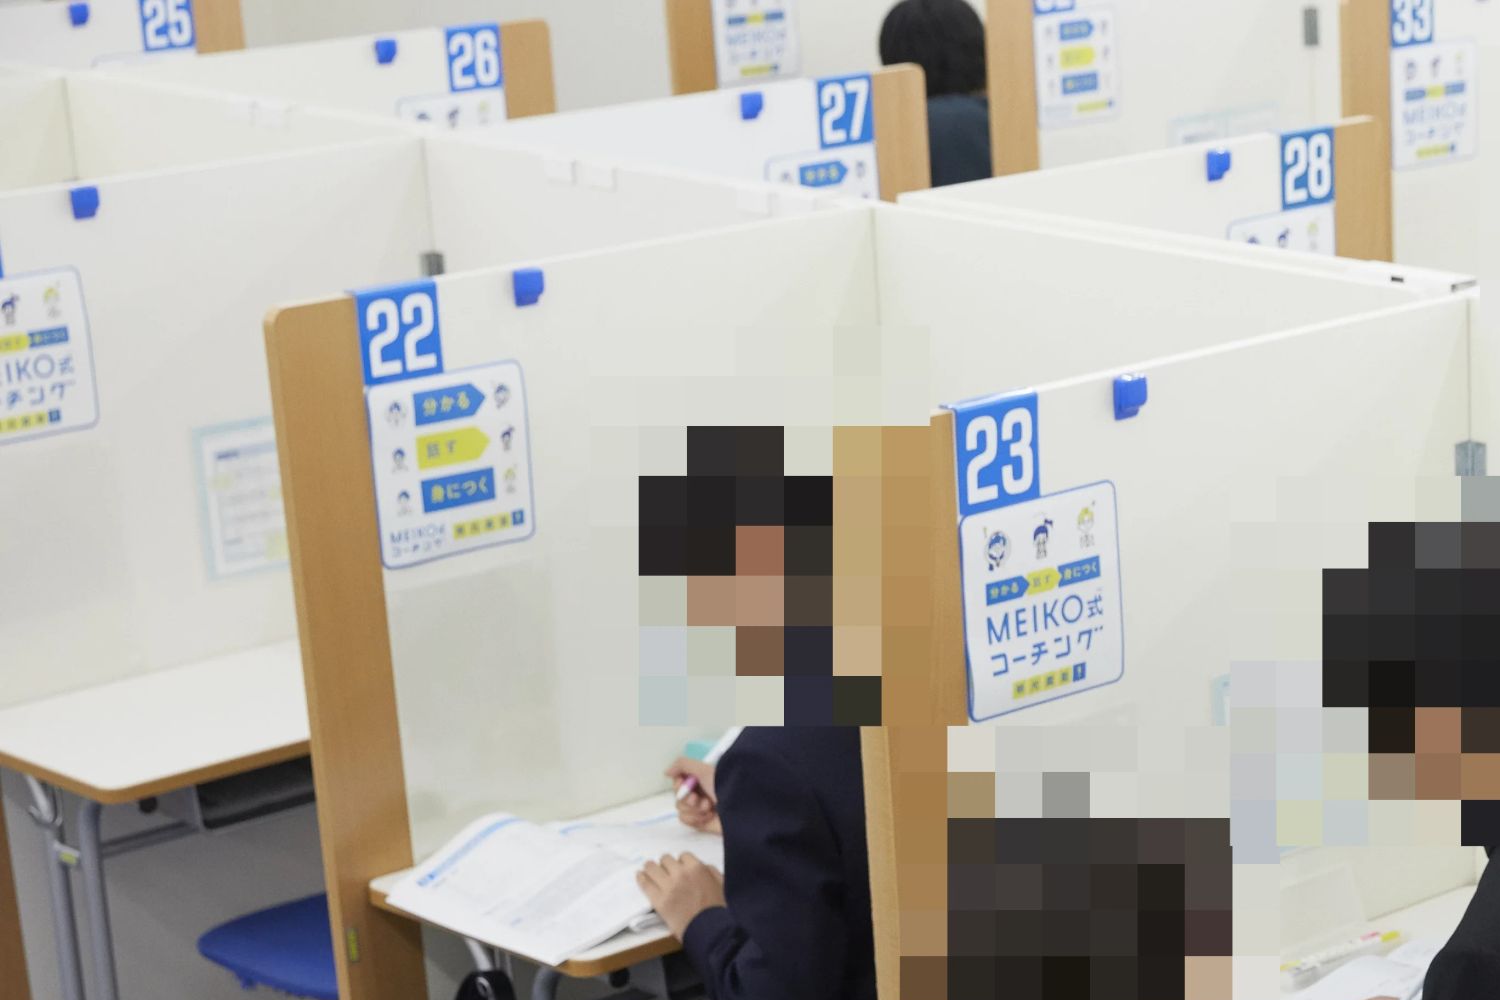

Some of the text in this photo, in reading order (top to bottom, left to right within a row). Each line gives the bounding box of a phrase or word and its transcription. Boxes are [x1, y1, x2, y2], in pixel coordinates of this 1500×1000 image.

[143, 0, 192, 49] 25
[1392, 0, 1431, 44] 33
[449, 29, 500, 90] 26
[820, 78, 870, 146] 27
[1284, 132, 1331, 205] 28
[366, 292, 437, 379] 22
[965, 406, 1034, 505] 23
[986, 590, 1104, 646] MEIKO式
[991, 625, 1104, 677] コーチング
